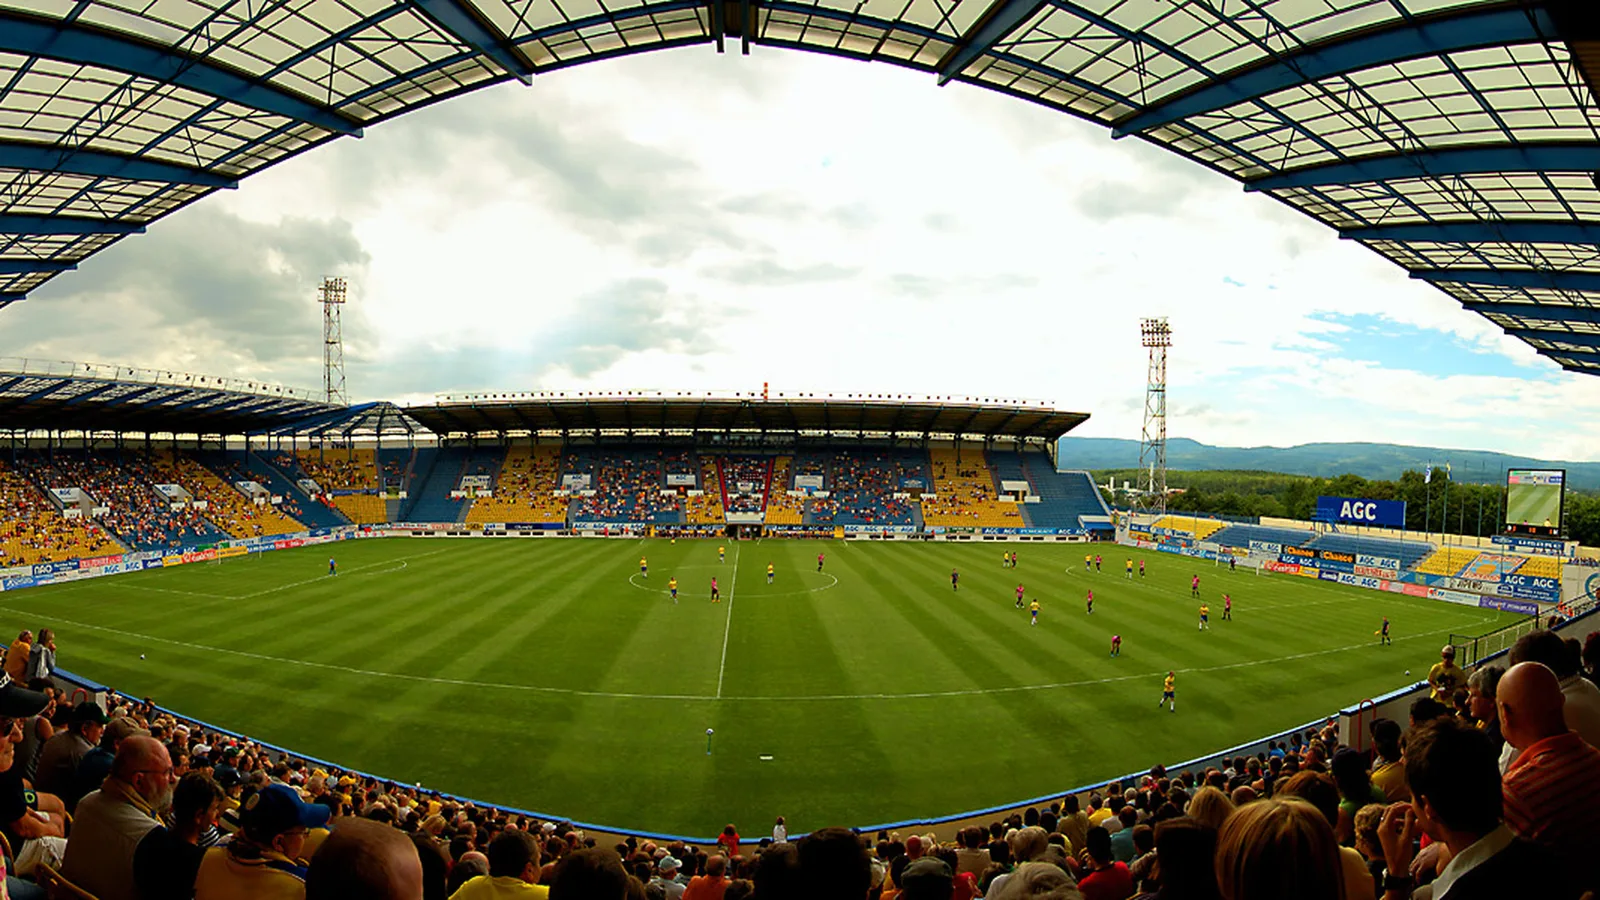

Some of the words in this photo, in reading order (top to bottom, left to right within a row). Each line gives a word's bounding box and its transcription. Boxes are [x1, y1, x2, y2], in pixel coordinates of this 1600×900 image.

[1340, 501, 1377, 521] AGC
[1251, 542, 1263, 550] AGC
[1267, 543, 1279, 552] AGC
[1281, 555, 1295, 563] AGC
[1299, 558, 1313, 566] AGC
[1359, 555, 1375, 565] AGC
[1380, 559, 1396, 568] AGC
[104, 564, 120, 574] AGC
[125, 561, 140, 571] AGC
[1341, 574, 1357, 584] AGC
[1361, 577, 1378, 587] AGC
[1505, 575, 1526, 585] AGC
[1533, 578, 1555, 589] AGC
